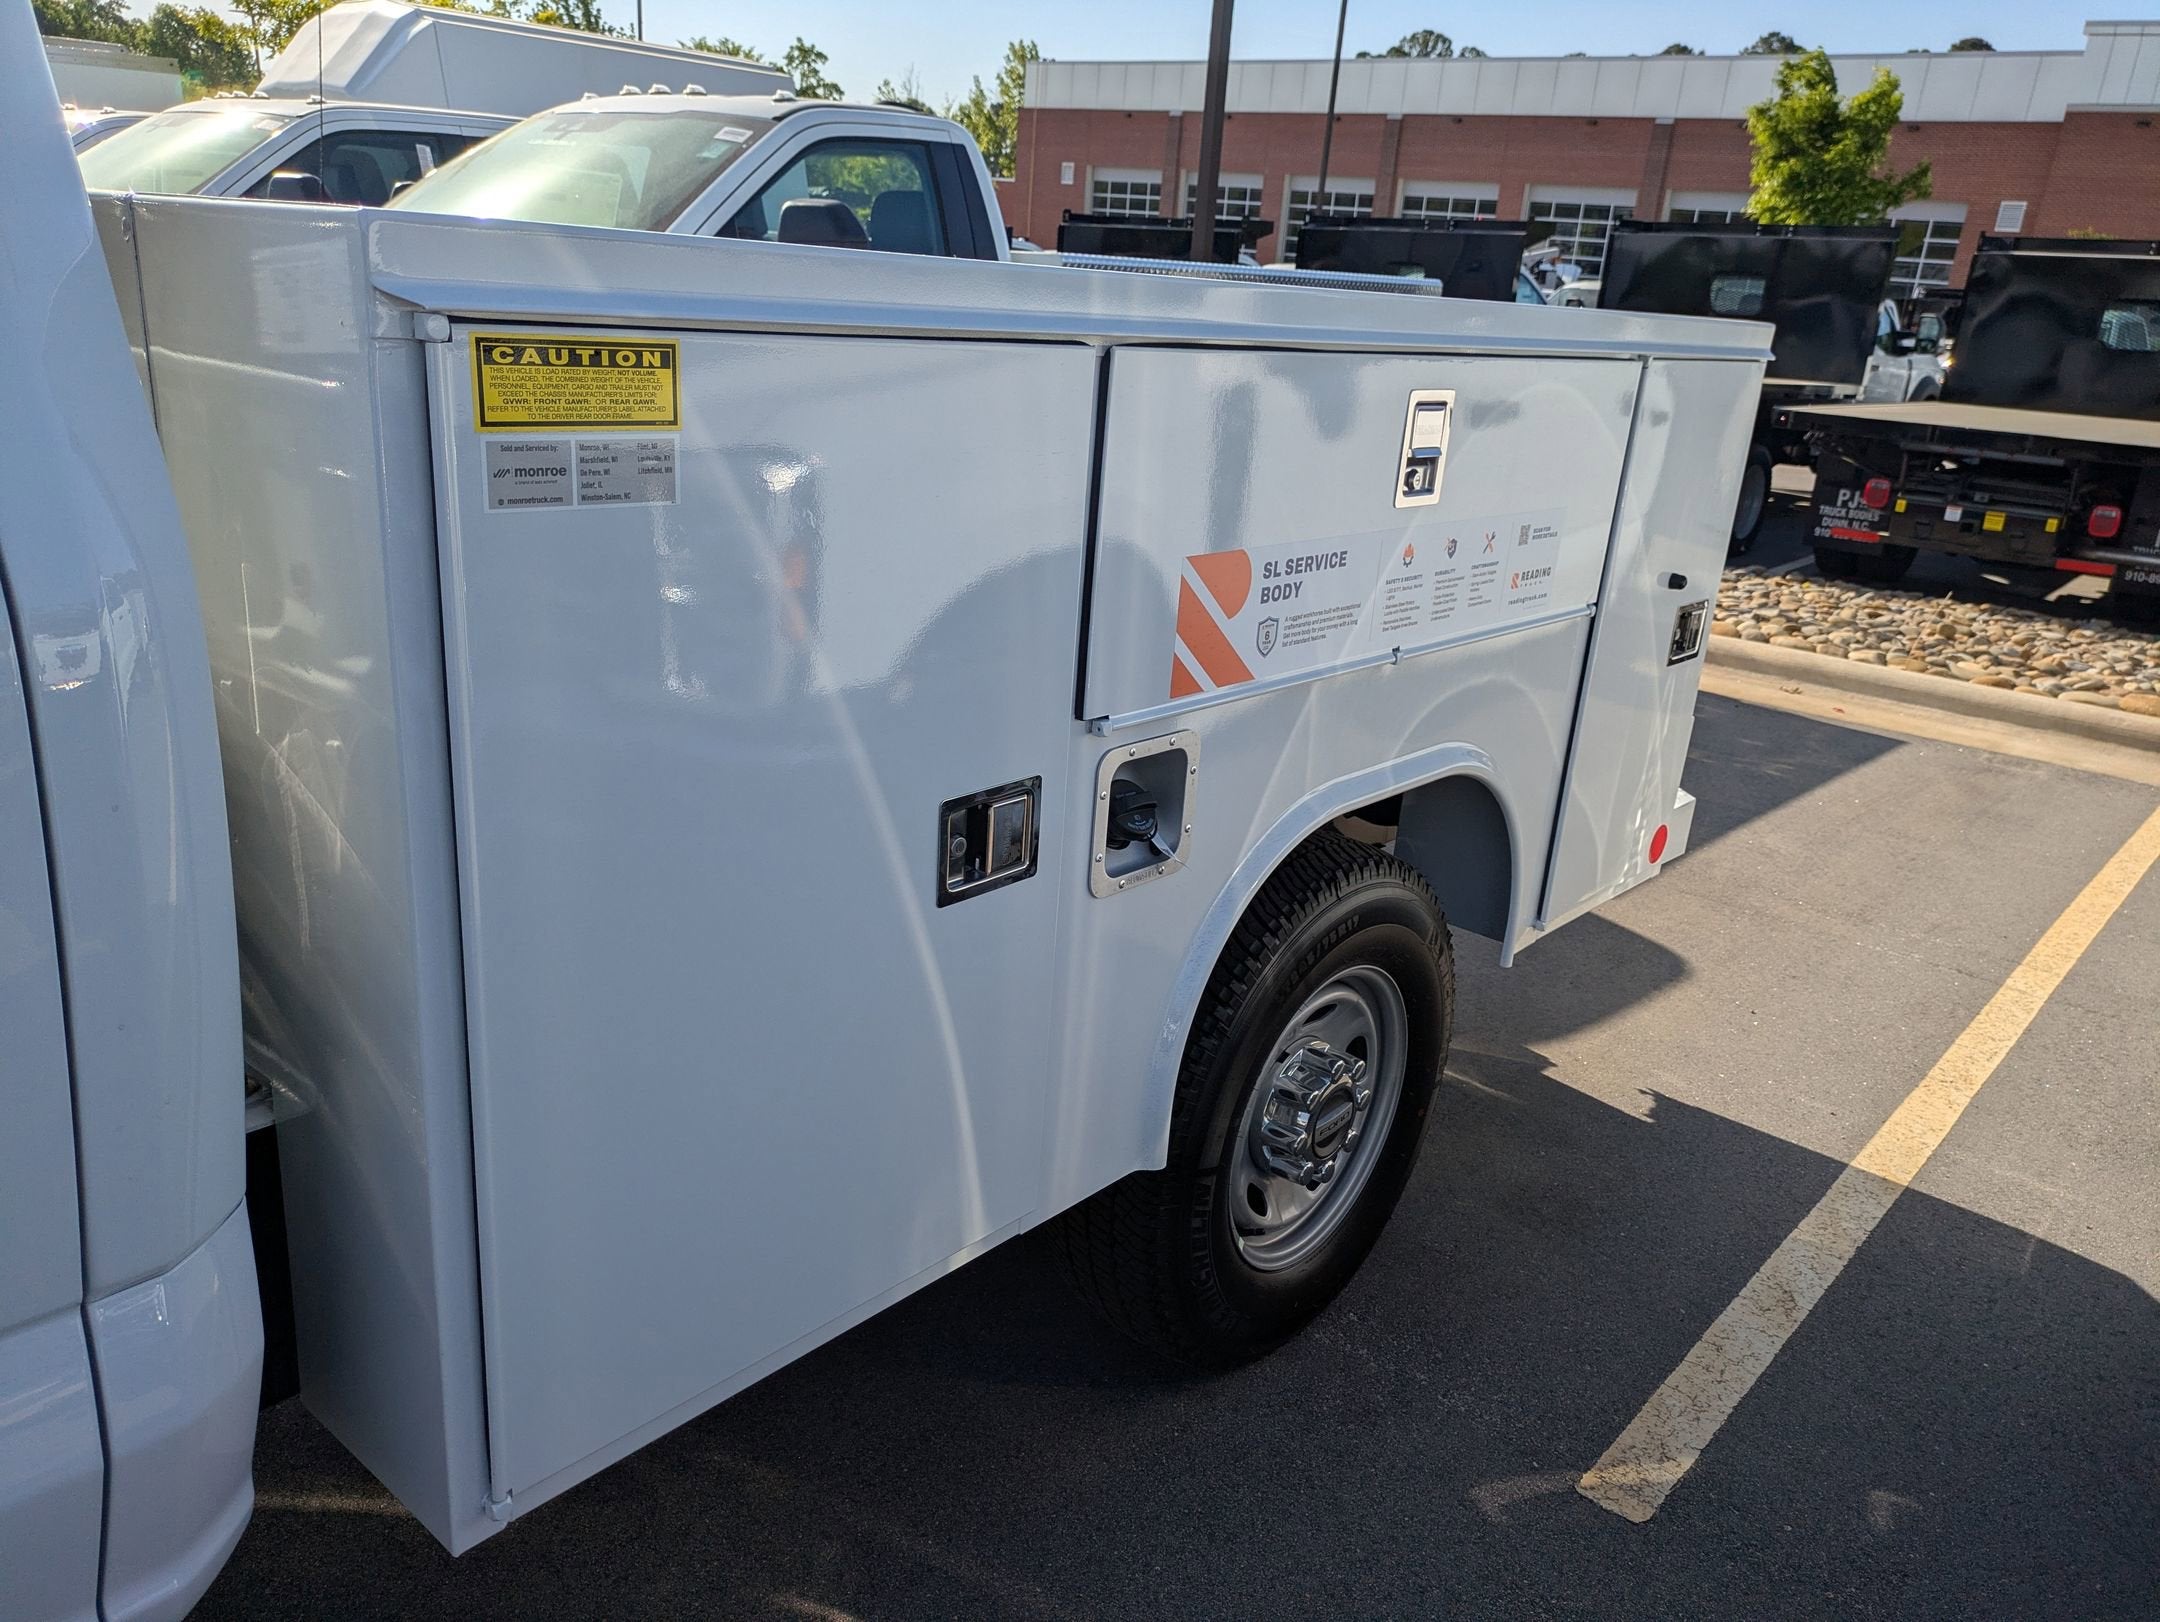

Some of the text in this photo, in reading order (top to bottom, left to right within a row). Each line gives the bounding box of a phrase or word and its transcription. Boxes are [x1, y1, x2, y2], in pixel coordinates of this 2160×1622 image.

[492, 346, 661, 366] CAUTION
[515, 467, 567, 477] monroe
[508, 496, 563, 504] monroetruck.com
[1819, 504, 1881, 522] TRUCK BODIES
[1263, 550, 1348, 579] SL SERVICE
[1521, 566, 1552, 582] READING
[1260, 581, 1303, 605] BODY
[1508, 593, 1548, 606] readingtruck.com
[1265, 631, 1270, 640] 6
[1320, 1111, 1350, 1136] FORD
